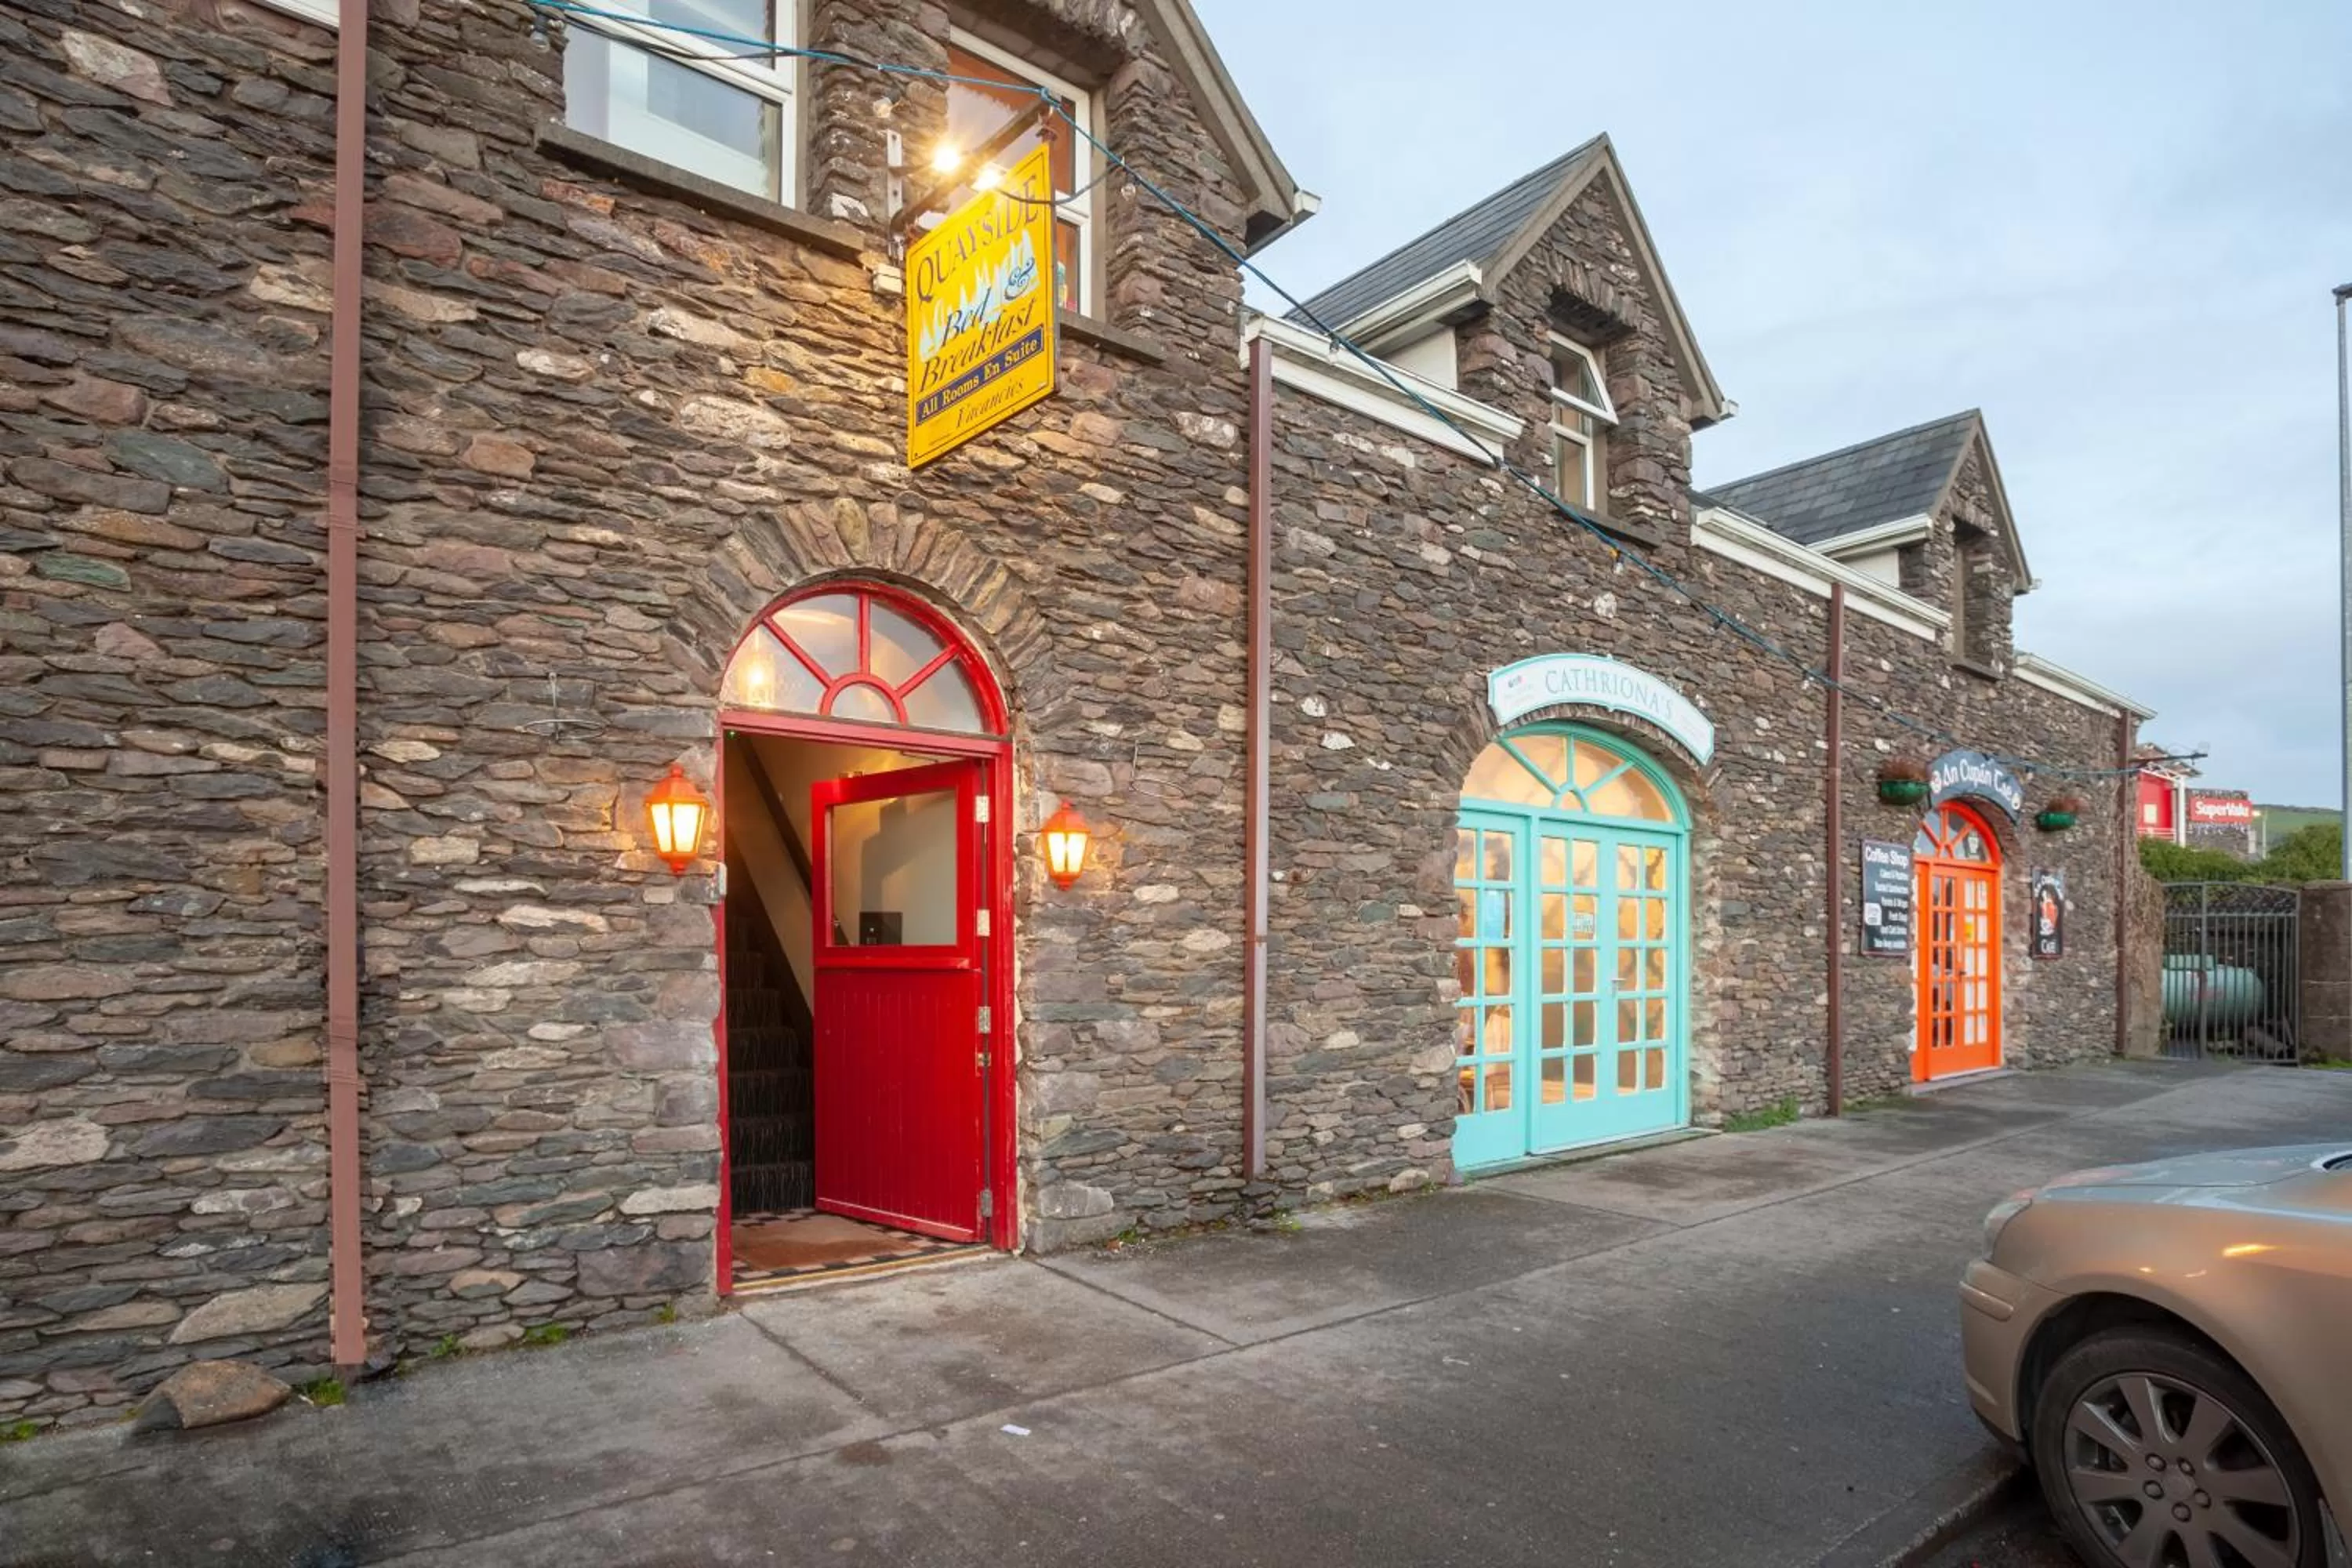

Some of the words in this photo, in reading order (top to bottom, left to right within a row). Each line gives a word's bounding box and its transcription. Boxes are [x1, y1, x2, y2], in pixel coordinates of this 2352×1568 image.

[916, 174, 1040, 303] QUAYSIDE
[941, 285, 992, 347] Bed
[1004, 257, 1035, 301] &
[919, 297, 1036, 392] Breakfast
[921, 399, 939, 419] All
[941, 375, 979, 411] Rooms
[983, 361, 1000, 382] En
[1004, 336, 1039, 369] Suite
[956, 377, 1025, 428] Vacancies
[1545, 667, 1674, 720] CATHRIONA'S
[1865, 845, 1889, 864] Coffee
[1889, 849, 1908, 869] Shop
